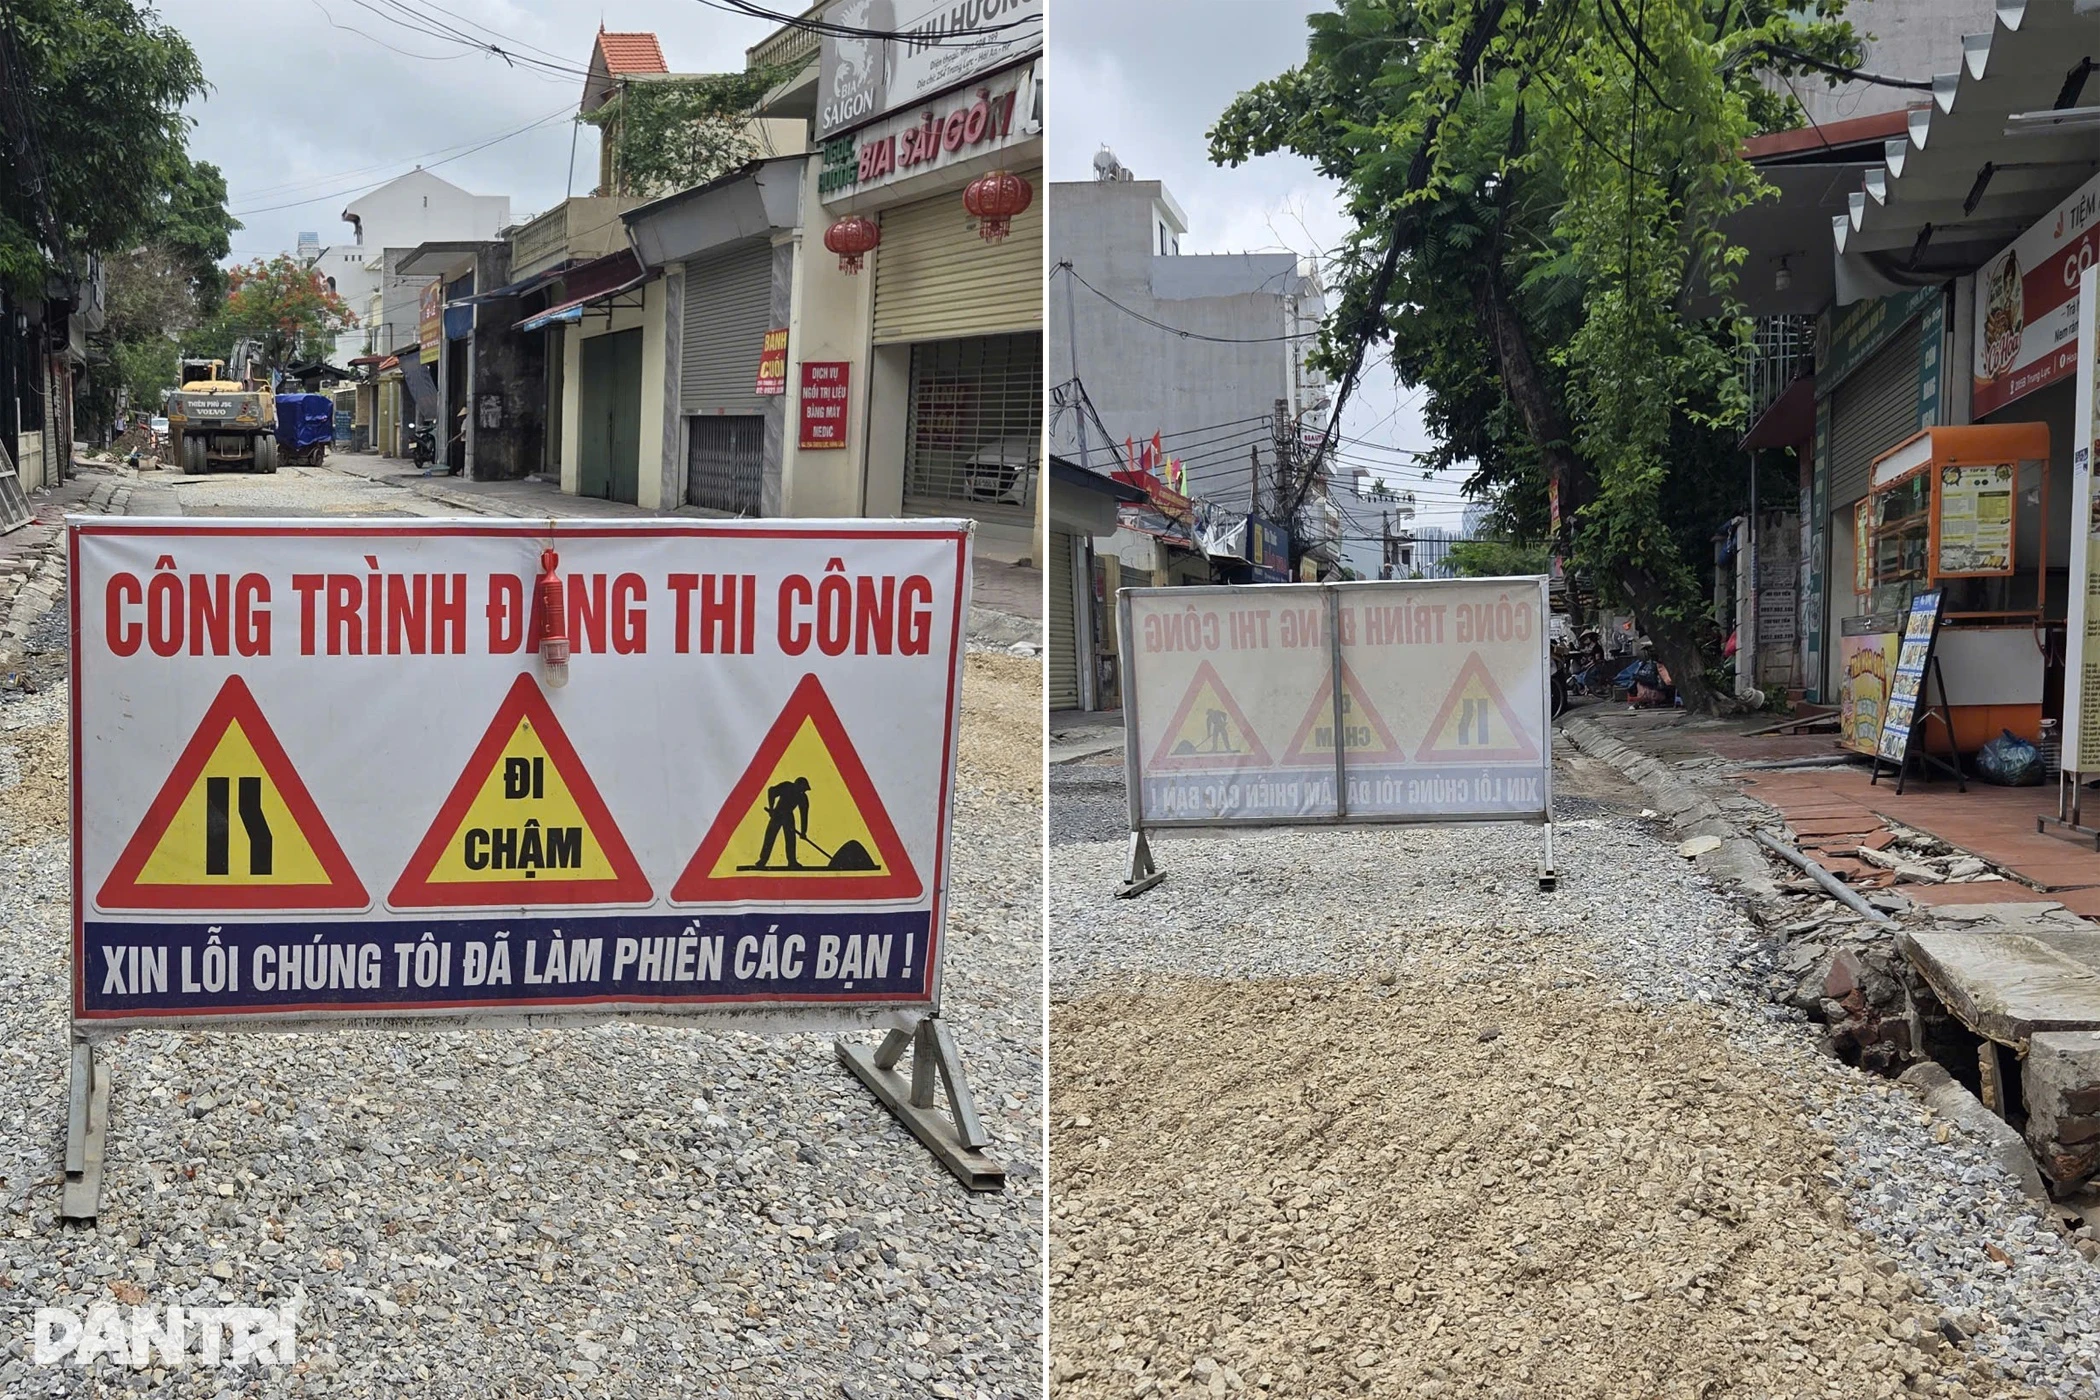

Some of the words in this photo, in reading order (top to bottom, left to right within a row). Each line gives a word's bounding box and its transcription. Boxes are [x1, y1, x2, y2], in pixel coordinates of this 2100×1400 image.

[822, 87, 875, 130] SAIGON
[840, 81, 857, 99] BIA
[857, 135, 896, 182] BIA
[2063, 235, 2093, 288] CÔ
[764, 329, 787, 352] BÁNH
[812, 367, 828, 381] DỊCH
[829, 367, 839, 381] VỤ
[820, 387, 831, 401] TRỊ
[187, 400, 206, 408] THIÊN
[196, 408, 227, 416] VOLVO
[105, 554, 272, 658] CÔNG
[291, 555, 467, 656] TRÌNH
[667, 572, 757, 655] THI
[777, 557, 934, 657] CÔNG
[503, 756, 544, 800] ĐI
[464, 818, 583, 879] CHẬM
[101, 945, 168, 995] XIN
[181, 925, 239, 994] LỖI
[252, 933, 382, 992] CHÚNG
[394, 931, 452, 988] TÔI
[462, 929, 512, 987] ĐÃ
[523, 929, 604, 985] LÀM
[612, 919, 724, 983] PHIỀN
[734, 924, 806, 980] CÁC
[814, 932, 893, 990] BẠN
[901, 932, 914, 979] !
